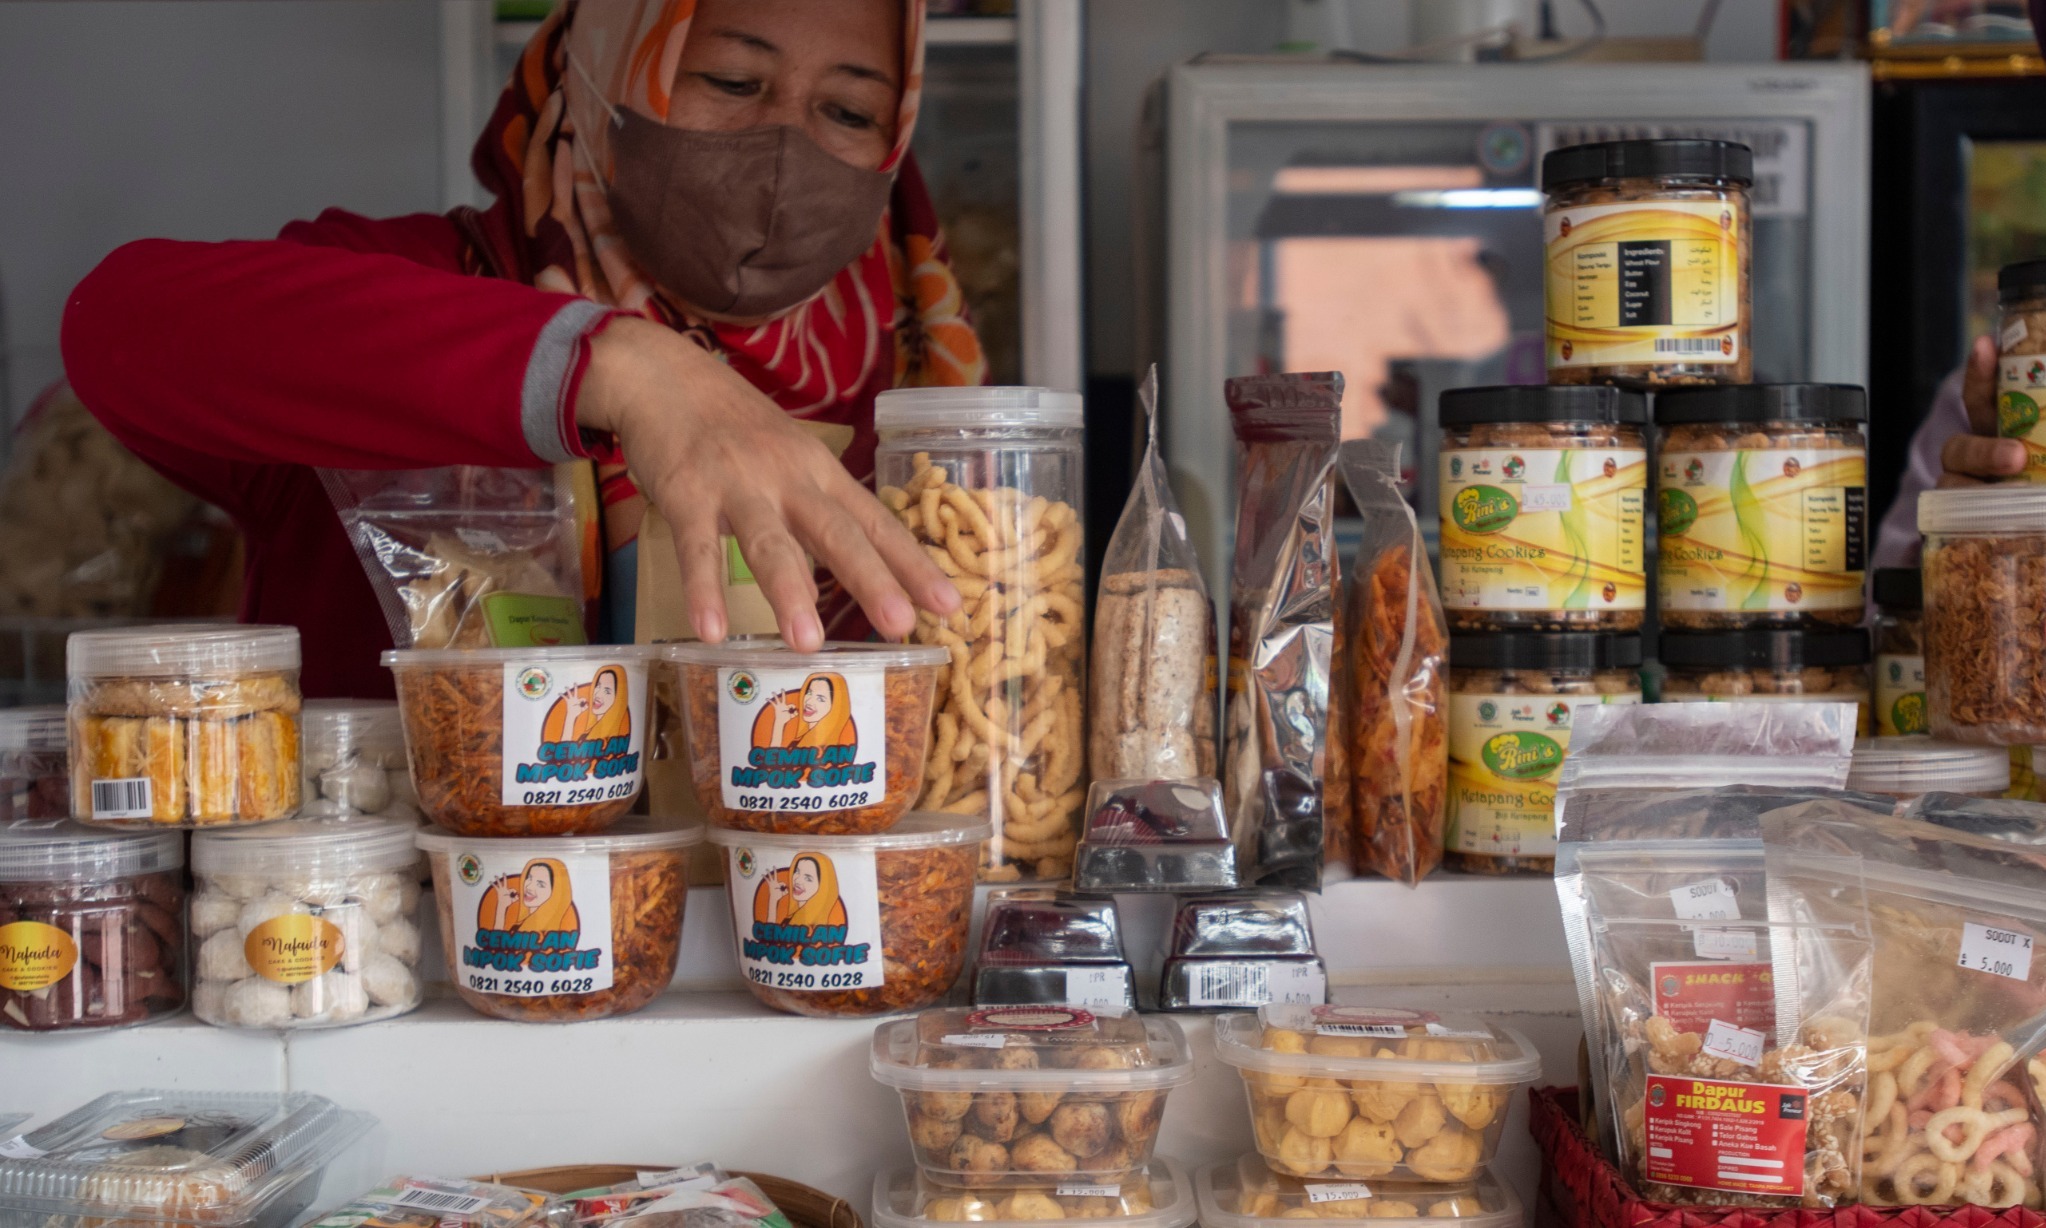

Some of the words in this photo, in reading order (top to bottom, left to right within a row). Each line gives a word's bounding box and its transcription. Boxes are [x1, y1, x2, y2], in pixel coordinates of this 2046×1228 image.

[1624, 280, 1637, 288] Egg
[1624, 290, 1650, 298] Coconut
[1486, 544, 1546, 560] Cookies
[538, 736, 630, 762] CEMILAN
[748, 744, 856, 768] CEMILAN
[516, 762, 590, 784] MPOK
[594, 751, 640, 779] SOFIE
[732, 766, 802, 789] MPOK
[807, 762, 876, 788] SOFIE
[523, 790, 562, 804] 0821
[566, 787, 604, 804] 2540
[608, 780, 634, 798] 6028
[740, 795, 774, 809] 0821
[779, 796, 822, 810] 2540
[828, 791, 868, 808] 6028
[1461, 788, 1524, 808] Ketapang
[475, 928, 579, 950] CEMILAN
[752, 921, 847, 944] CEMILAN
[0, 944, 62, 965] Nafaida
[262, 936, 328, 956] Nafaida
[743, 937, 795, 966] MPOK
[799, 942, 871, 966] SOFIE
[463, 946, 523, 972] MPOK
[528, 948, 602, 972] SOFIE
[1980, 956, 2013, 976] 5.000
[469, 974, 498, 991] 0821
[504, 980, 544, 994] 2540
[551, 977, 594, 993] 6028
[749, 967, 772, 984] 0821
[777, 972, 815, 988] 2540
[821, 972, 864, 988] 6028
[1692, 1082, 1746, 1098] Dapur
[1676, 1094, 1766, 1114] FIRDAUS
[1654, 1117, 1674, 1126] Keripik
[1674, 1119, 1702, 1129] Singkong
[1734, 1124, 1758, 1134] Pisang
[1654, 1134, 1673, 1142] Keripik
[1674, 1136, 1694, 1144] Pisang
[1718, 1140, 1739, 1148] Aneka
[1755, 1144, 1776, 1152] Basah
[1736, 1133, 1758, 1141] Gabus
